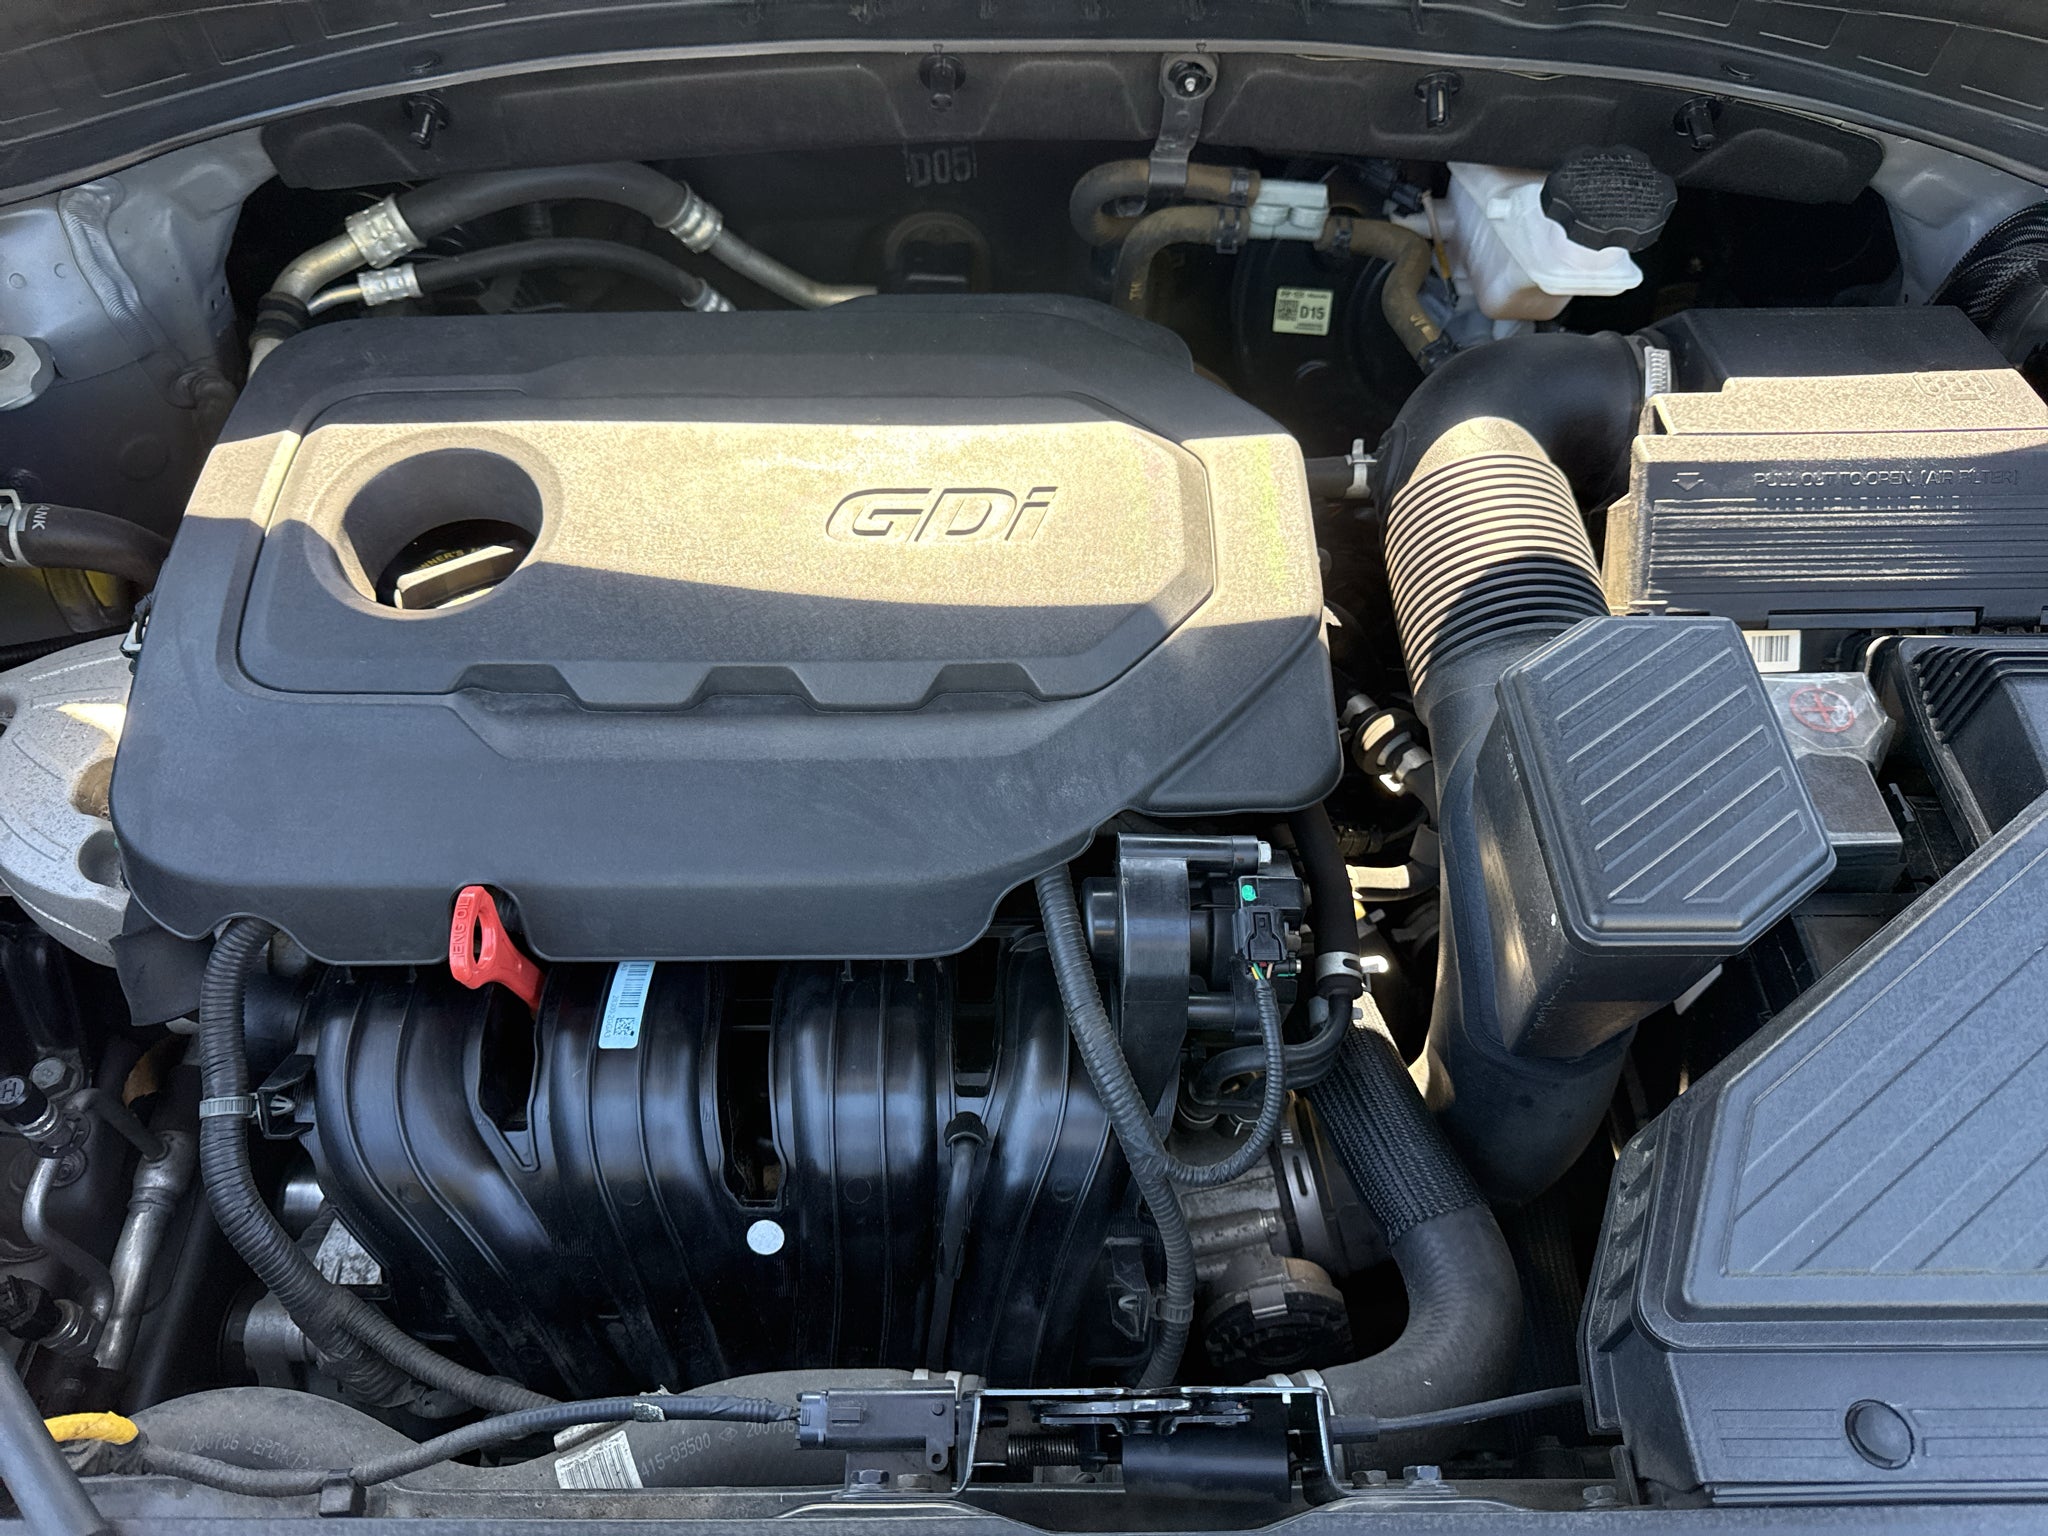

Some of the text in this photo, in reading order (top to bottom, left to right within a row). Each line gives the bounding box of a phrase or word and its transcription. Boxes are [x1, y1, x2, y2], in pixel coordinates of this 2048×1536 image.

[909, 146, 972, 188] D05
[1299, 305, 1325, 321] D15
[1754, 472, 1797, 487] PULL
[1800, 471, 1837, 486] OUT
[1839, 471, 1861, 486] TO
[1865, 470, 1911, 486] OPEN
[825, 485, 1059, 543] GDi
[452, 896, 471, 958] ENG OIL
